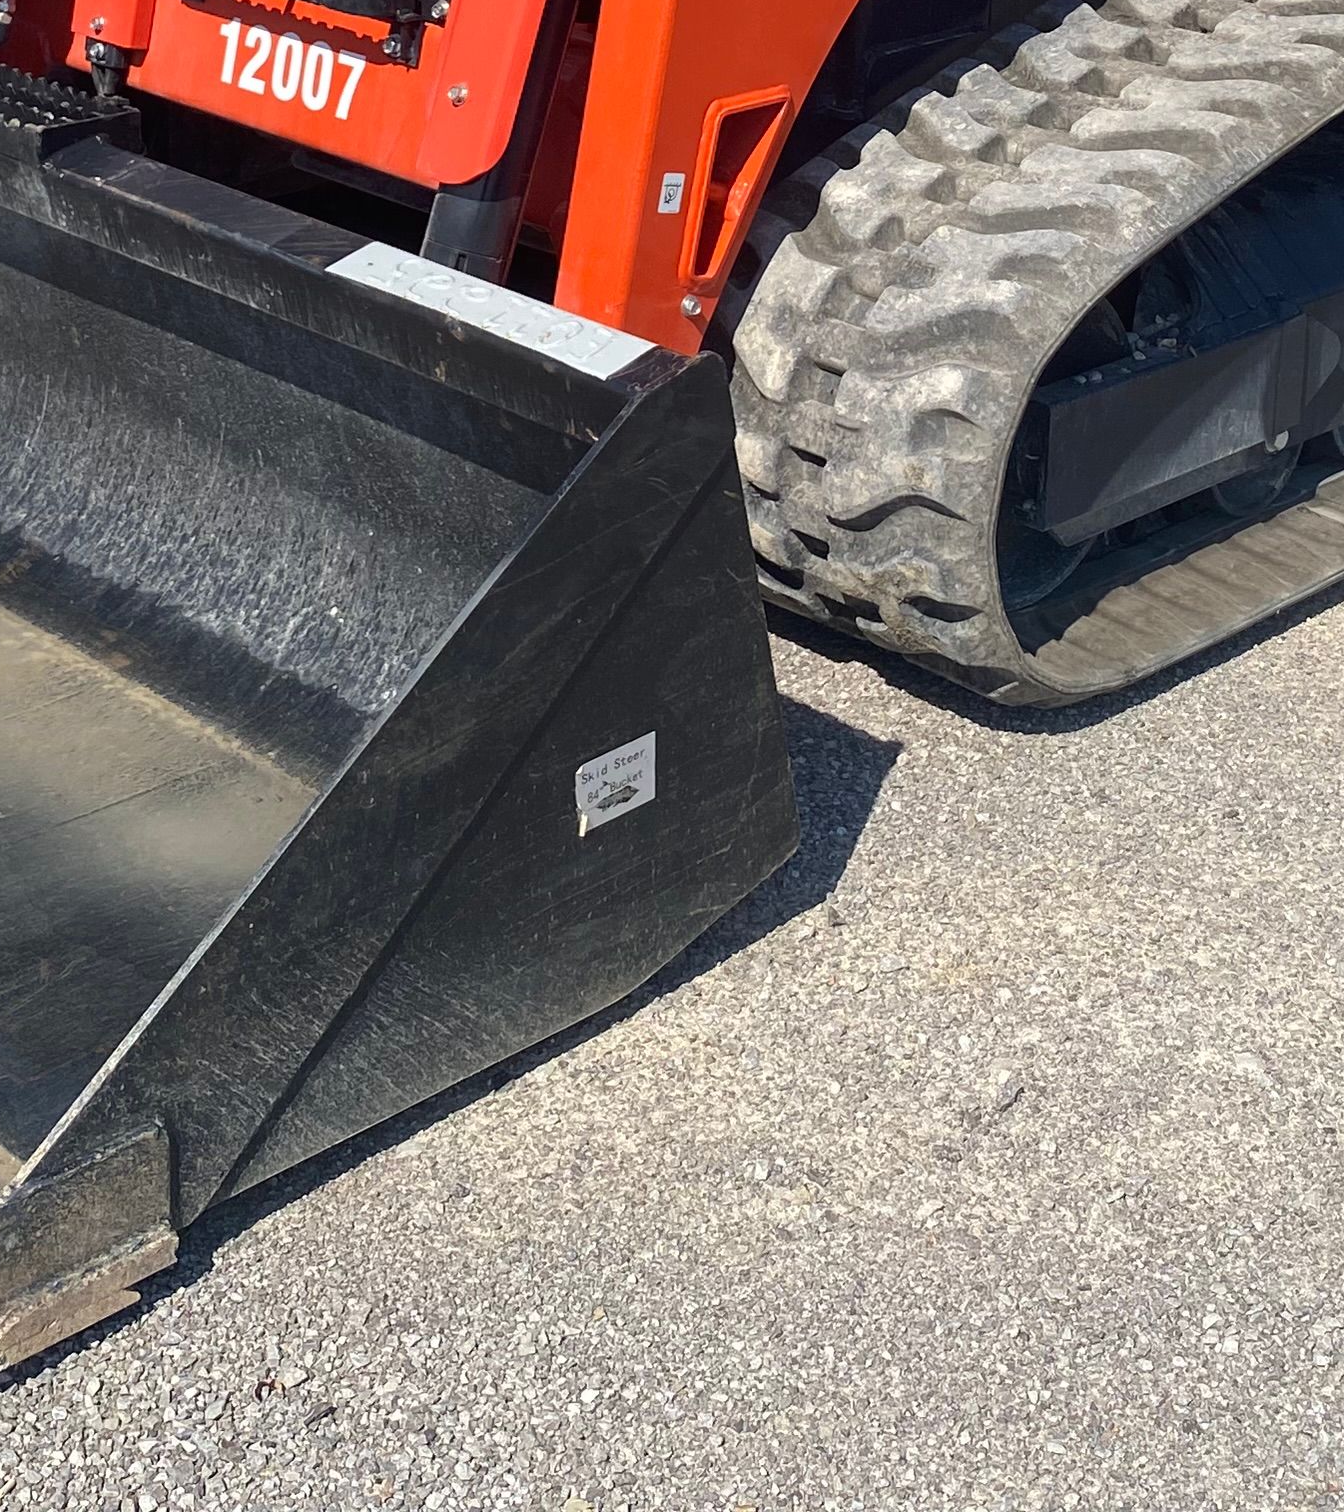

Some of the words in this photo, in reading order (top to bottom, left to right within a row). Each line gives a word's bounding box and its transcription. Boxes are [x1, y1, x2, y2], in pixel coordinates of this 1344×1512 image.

[219, 17, 366, 120] 12007
[581, 764, 608, 785] Skid
[613, 749, 646, 770] Steer
[608, 769, 643, 792] Bucket
